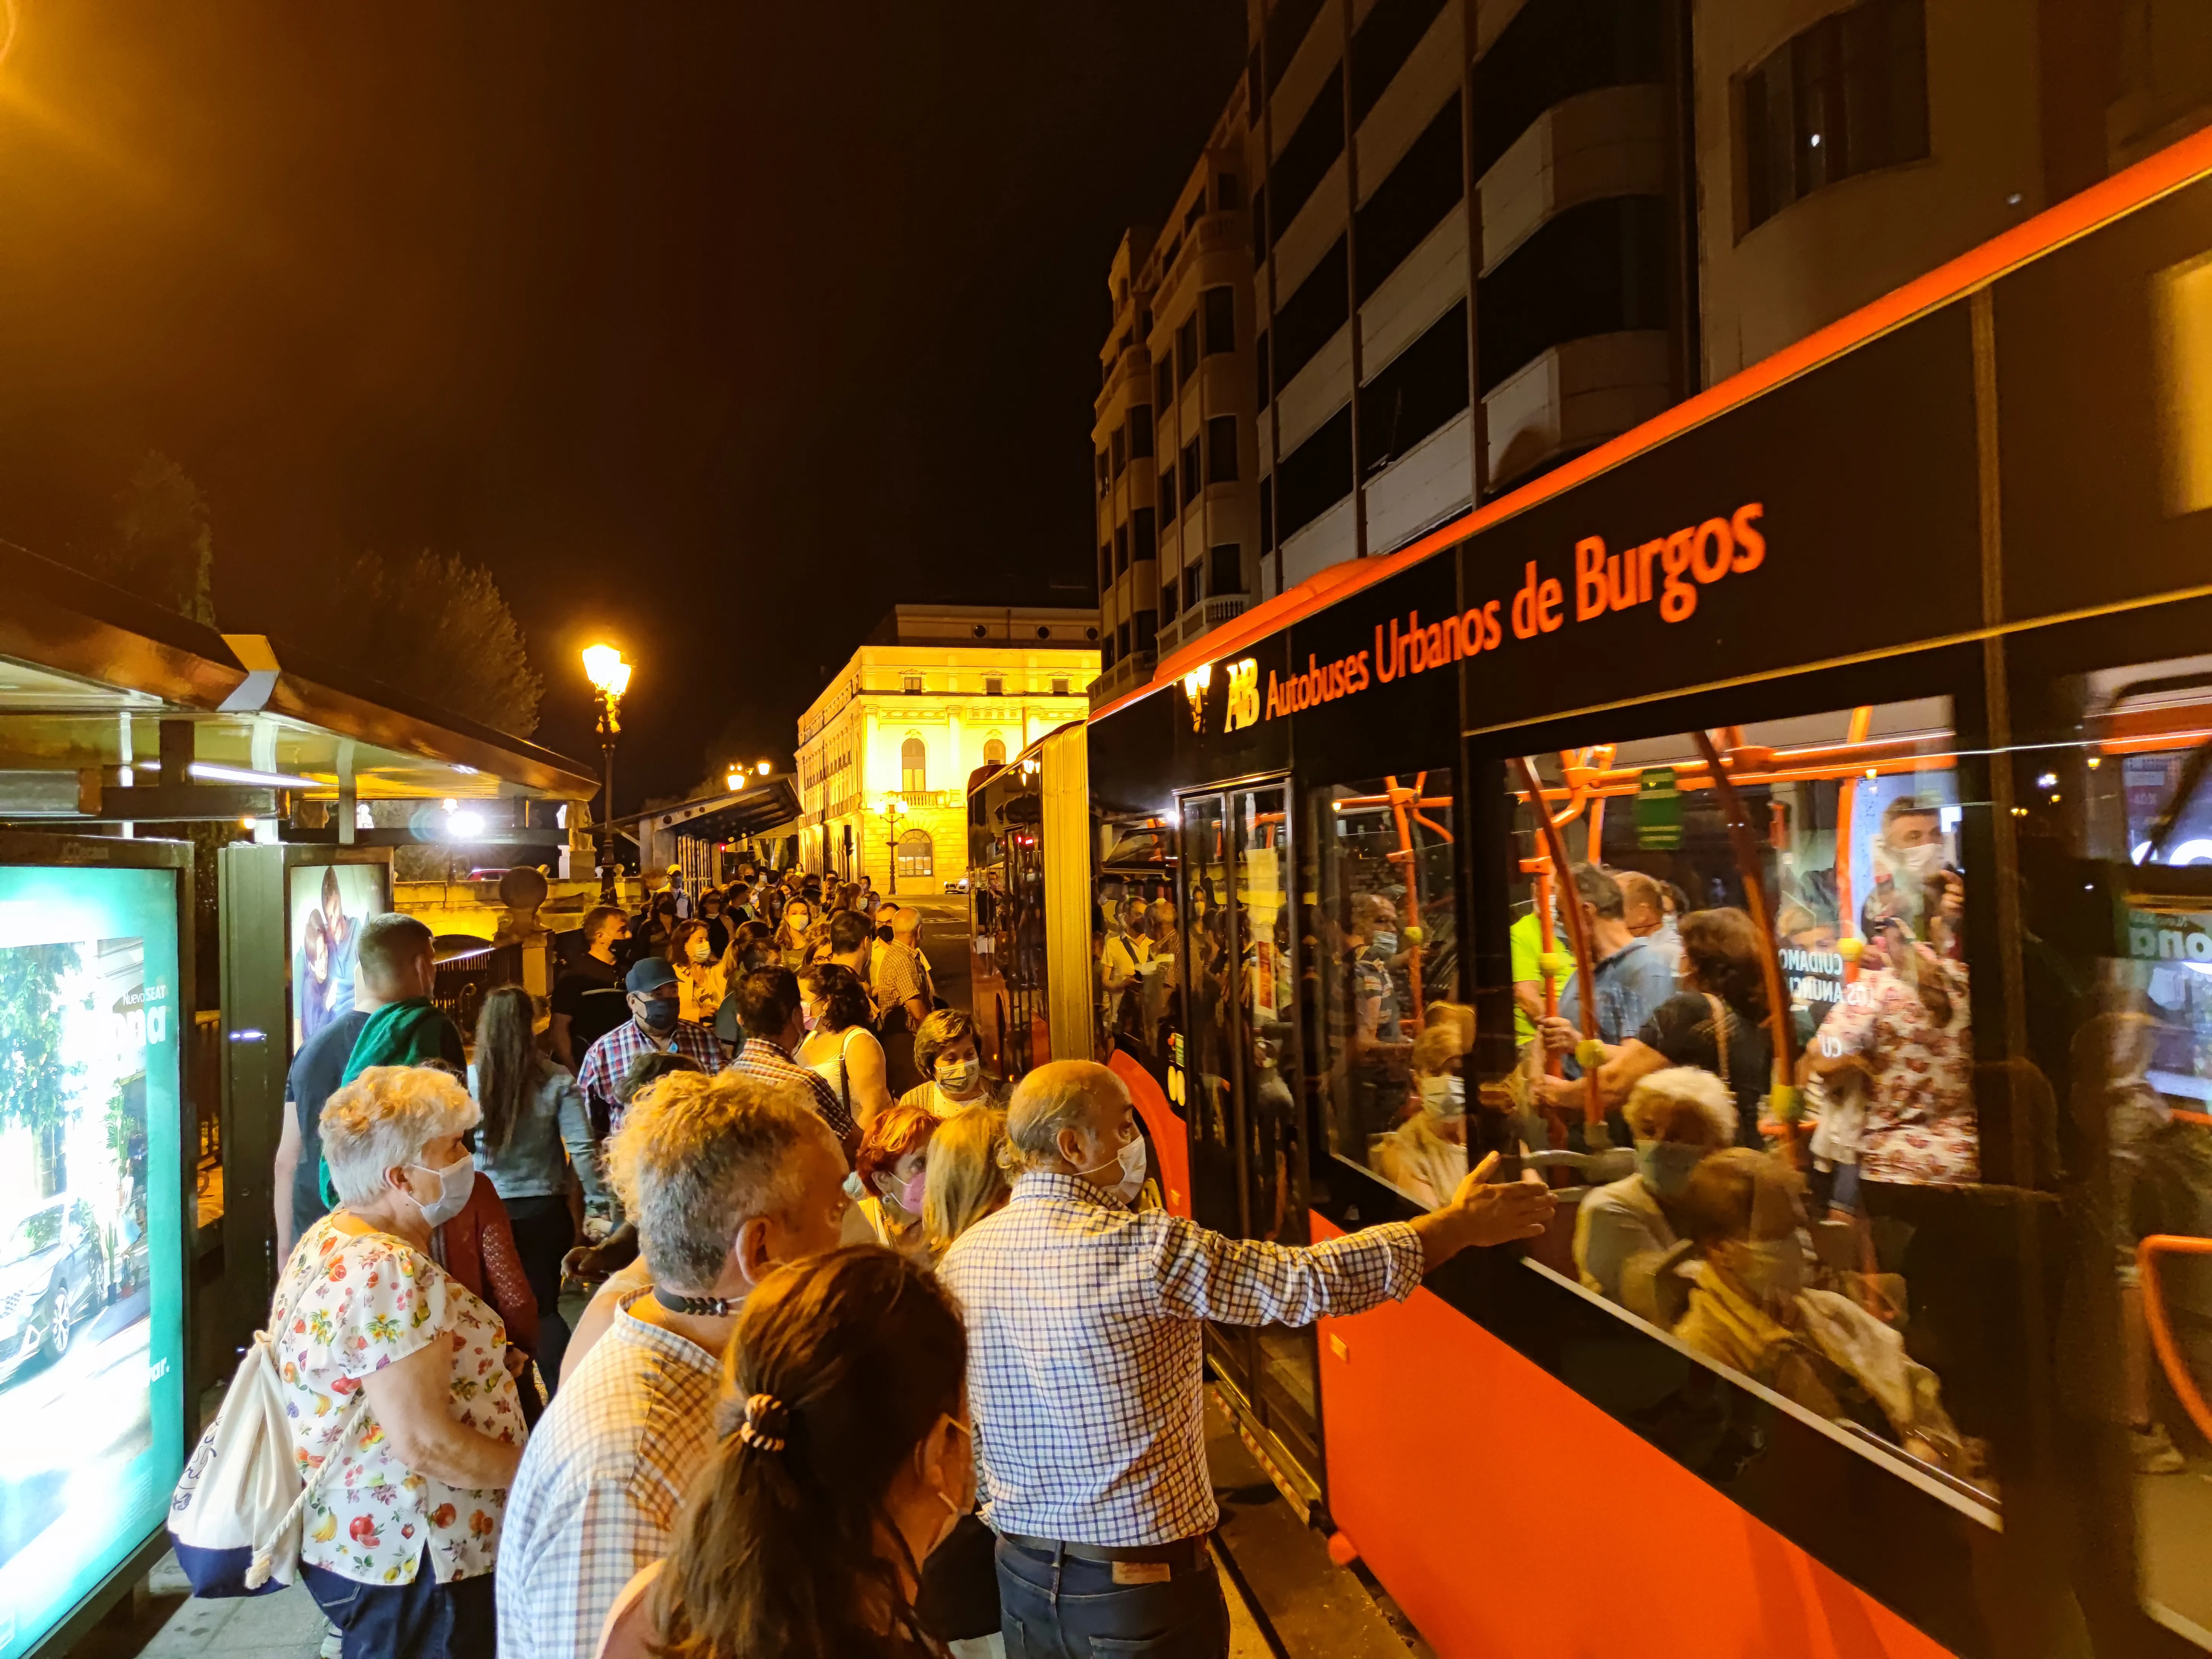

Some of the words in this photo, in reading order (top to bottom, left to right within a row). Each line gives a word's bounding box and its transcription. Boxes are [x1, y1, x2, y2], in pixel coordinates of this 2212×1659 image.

[1265, 650, 1370, 721] Autobuses
[1375, 600, 1502, 683] Urbanos
[1512, 561, 1564, 639] de
[1575, 502, 1766, 623] Burgos
[123, 993, 145, 1006] Nuevo
[145, 985, 166, 1002] SEAT
